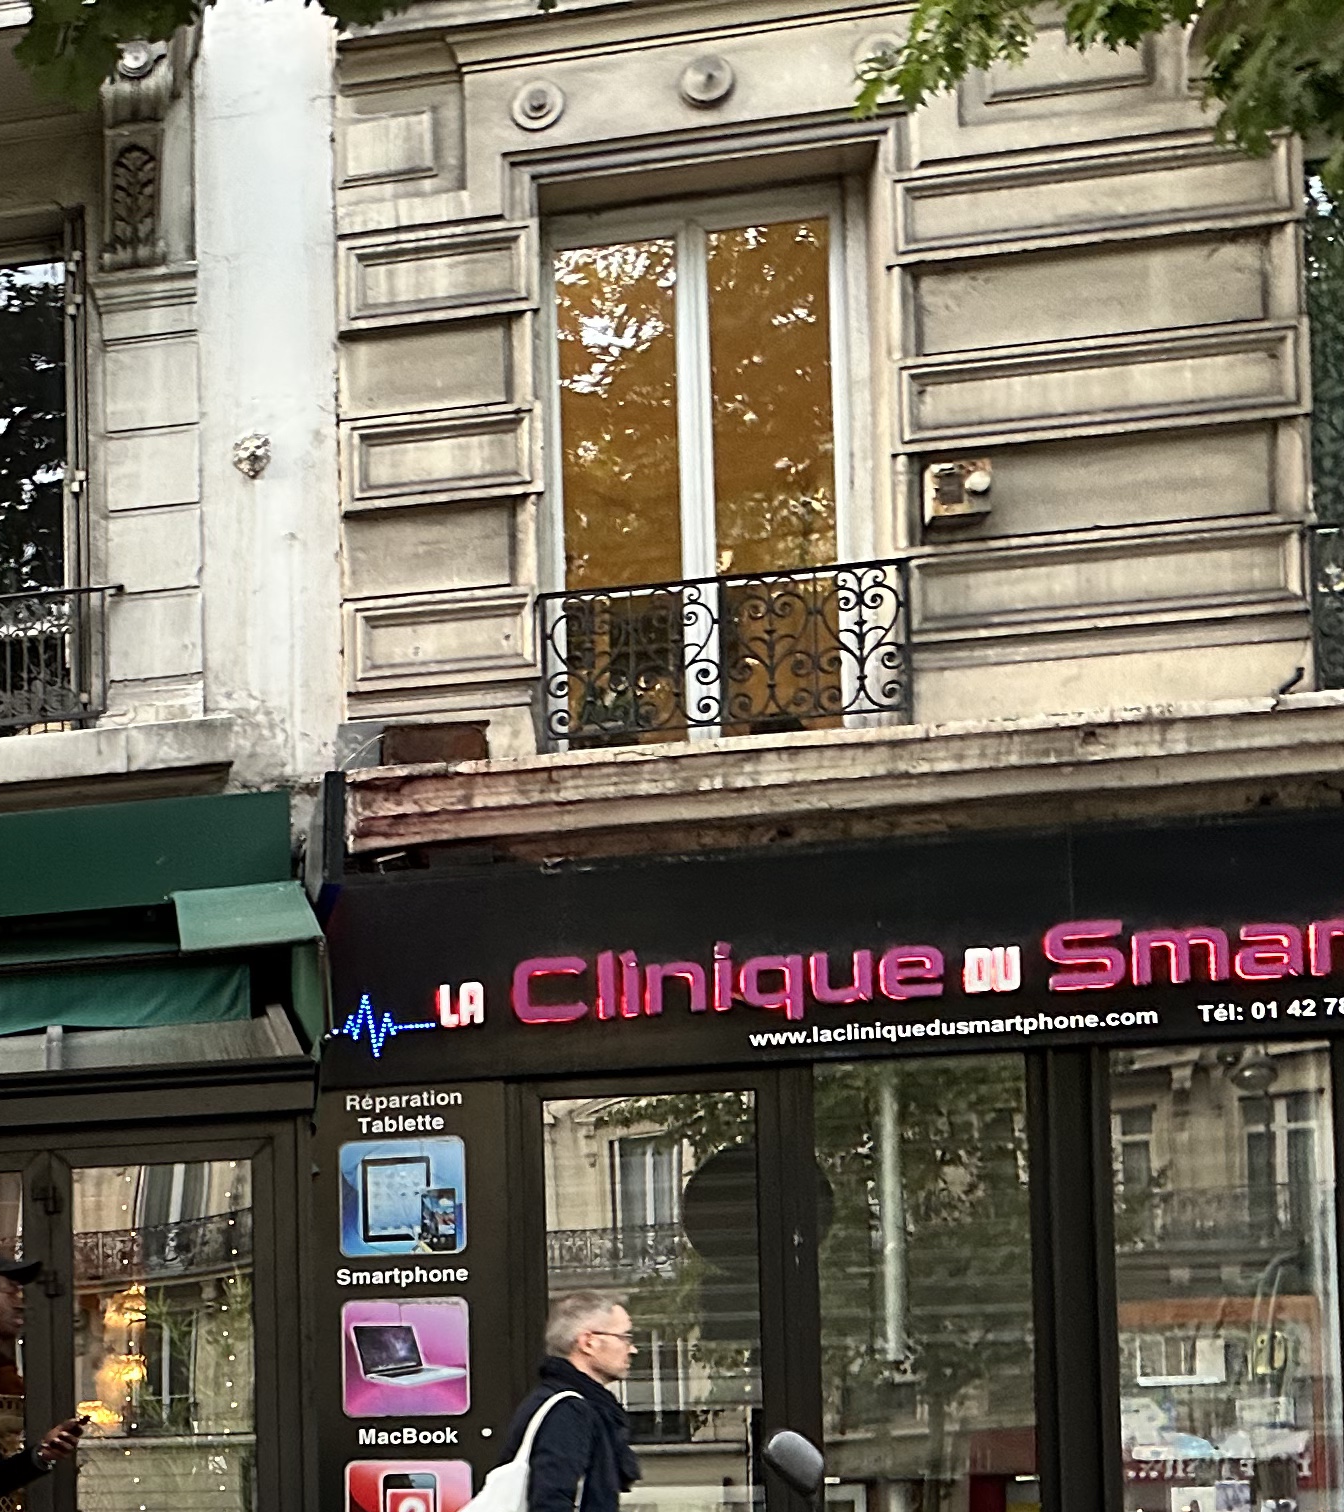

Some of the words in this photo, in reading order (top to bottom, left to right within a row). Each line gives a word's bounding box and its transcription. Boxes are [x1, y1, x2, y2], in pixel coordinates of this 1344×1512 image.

[436, 981, 485, 1029] LA
[513, 940, 946, 1025] Clinique
[963, 944, 1022, 994] DU
[748, 1007, 1159, 1048] www.lacliniquedusmartphone.com
[1197, 1002, 1244, 1023] Tél:
[1250, 1000, 1278, 1020] 01
[1286, 998, 1317, 1018] 42
[345, 1089, 463, 1114] Réparation
[358, 1115, 445, 1134] Tablette
[336, 1266, 470, 1288] Smartphone
[358, 1427, 459, 1445] MacBook
